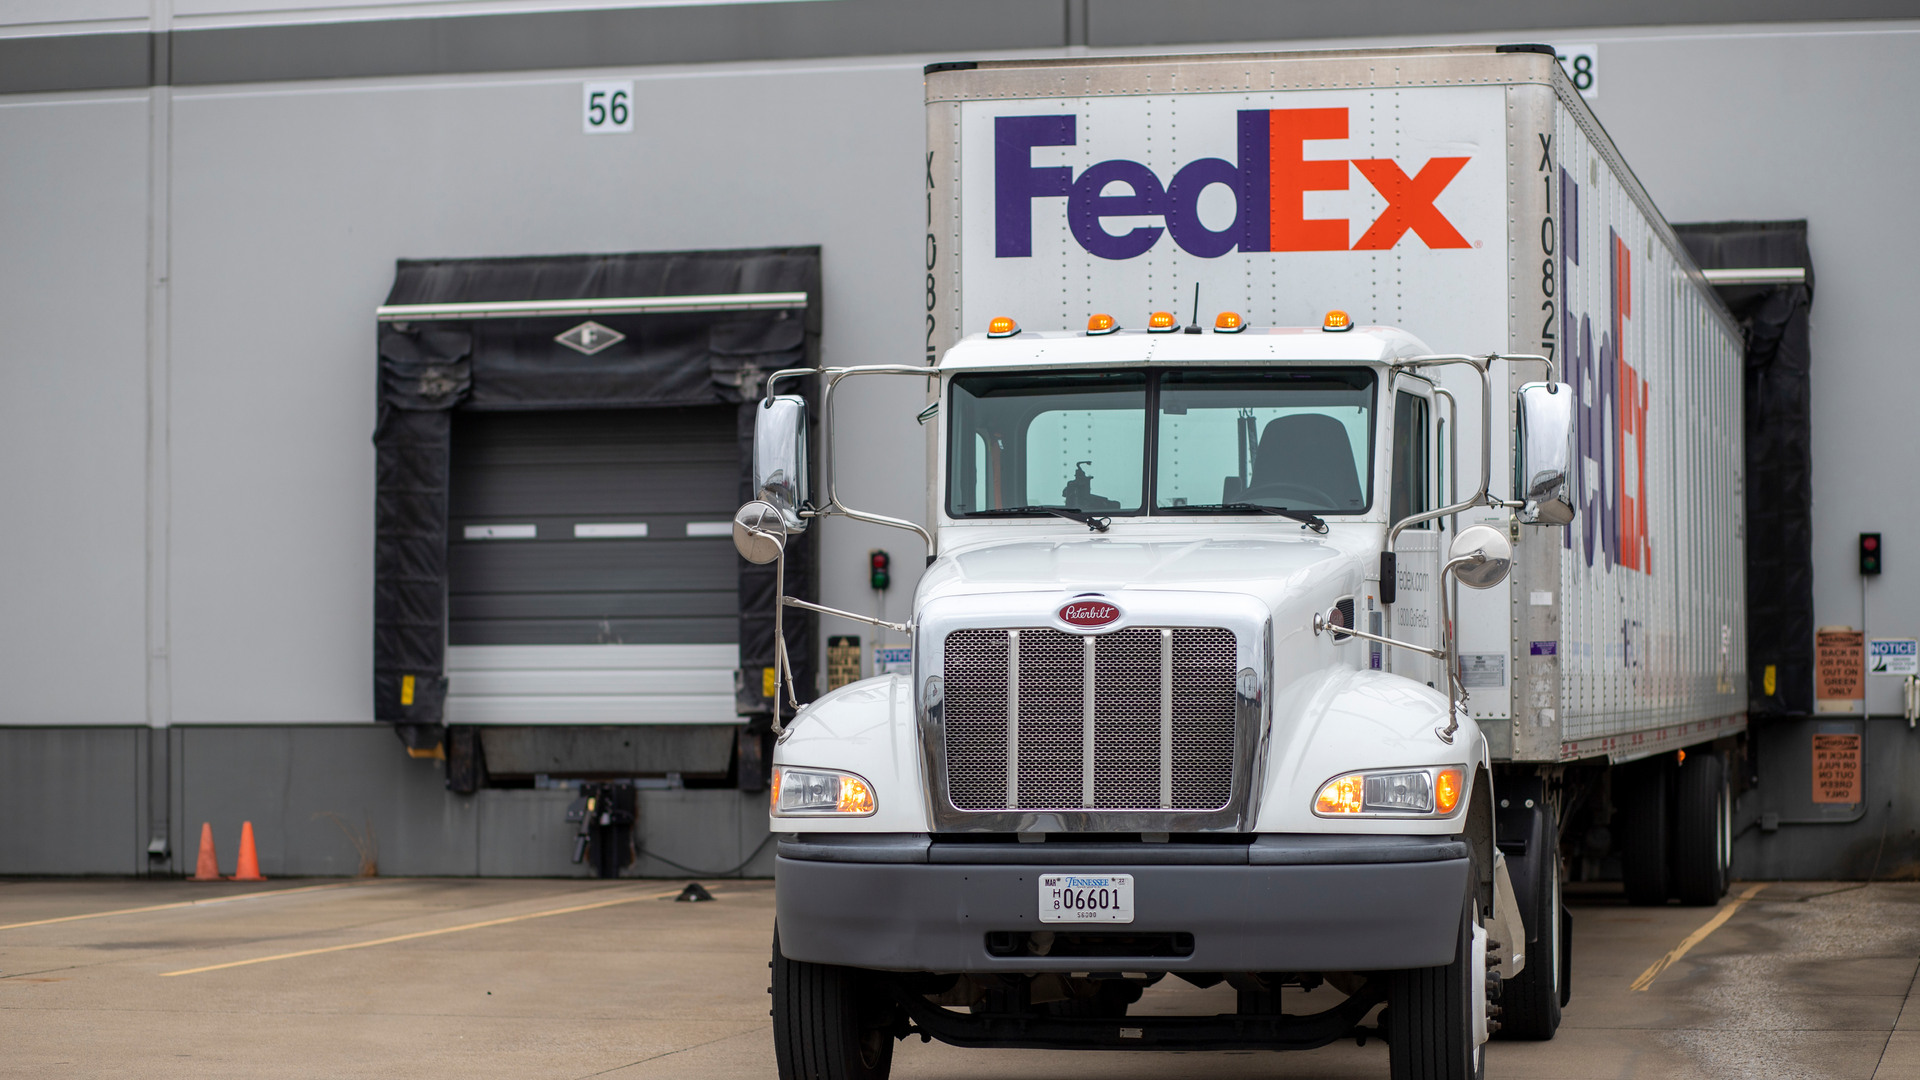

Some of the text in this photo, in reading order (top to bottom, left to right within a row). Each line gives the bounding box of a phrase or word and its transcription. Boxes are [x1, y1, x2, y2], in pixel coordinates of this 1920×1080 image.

[1557, 54, 1593, 90] 8
[589, 91, 628, 125] 56
[994, 107, 1473, 260] FedEx
[1397, 562, 1430, 592] fedex.com
[1065, 605, 1115, 620] Peterbilt
[1821, 649, 1859, 657] BACK IN
[1871, 643, 1916, 654] NOTICE
[1820, 659, 1860, 667] OR PULL
[1822, 668, 1858, 676] OUT ON
[1824, 678, 1857, 686] GREEN
[1828, 687, 1853, 696] ONLY
[1045, 879, 1057, 887] MAR
[1063, 888, 1120, 910] 06601
